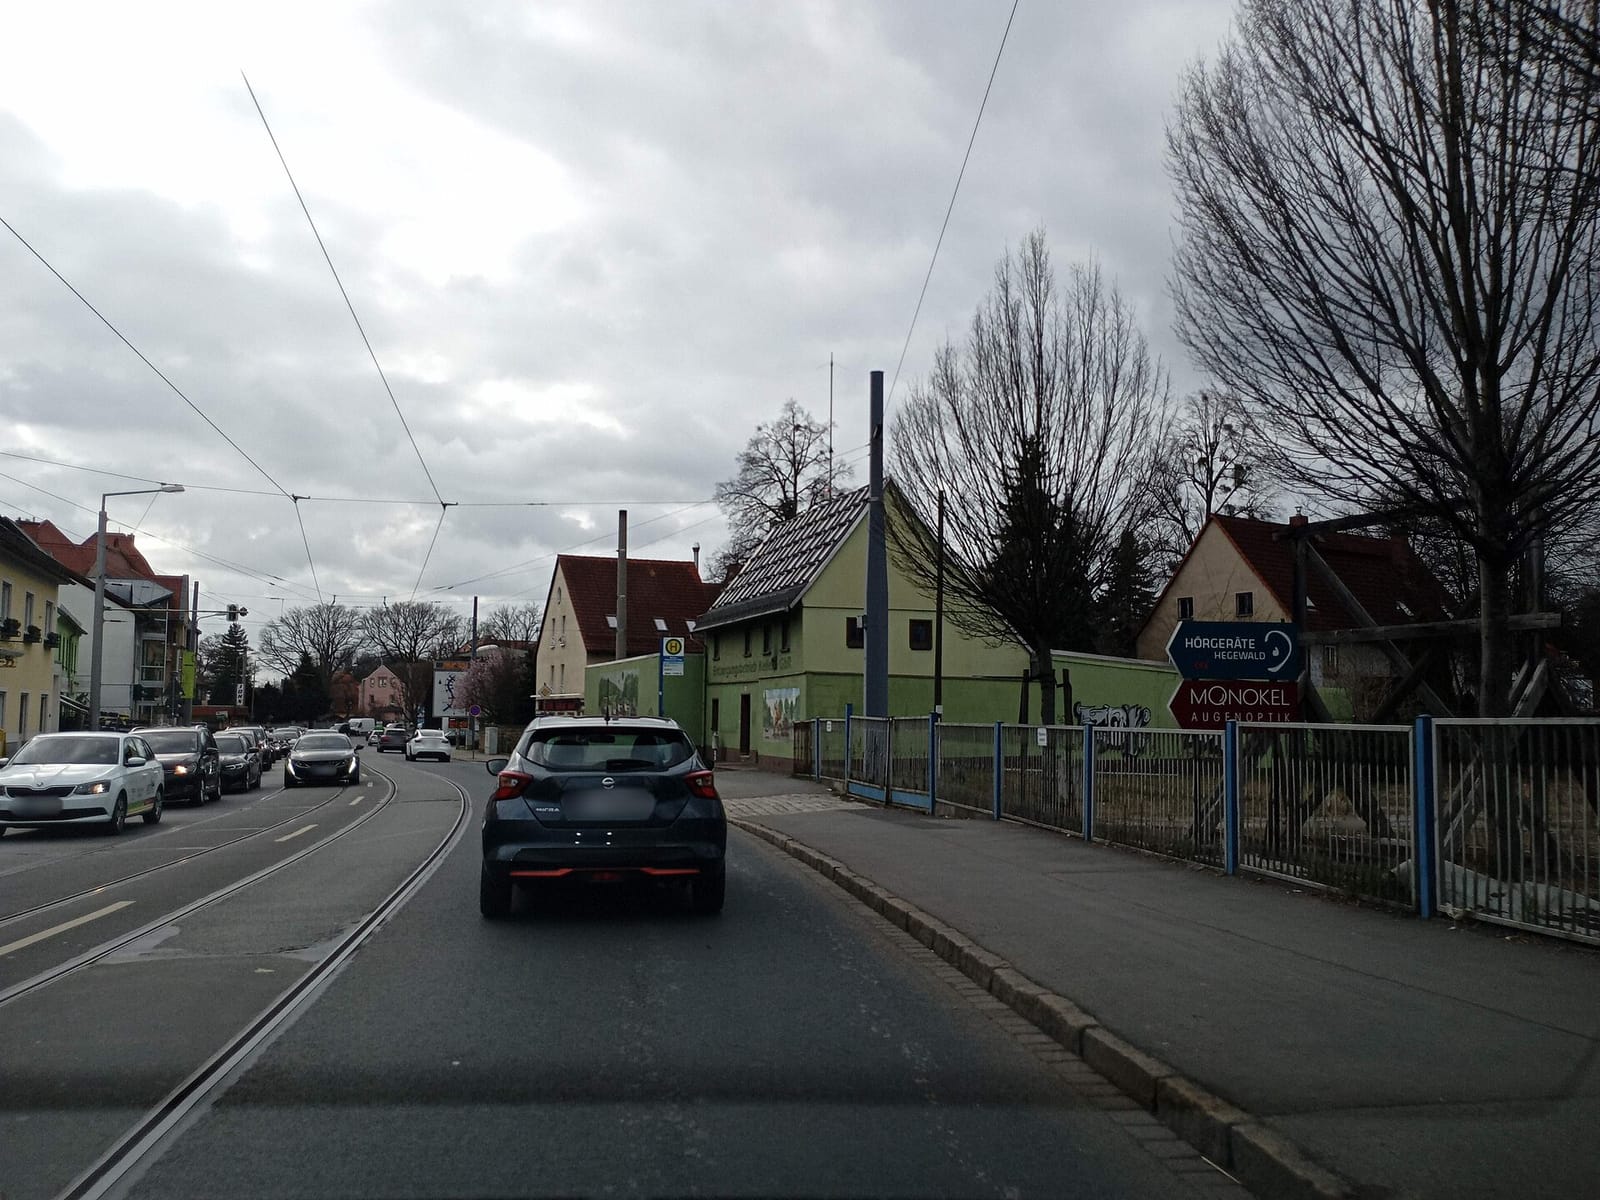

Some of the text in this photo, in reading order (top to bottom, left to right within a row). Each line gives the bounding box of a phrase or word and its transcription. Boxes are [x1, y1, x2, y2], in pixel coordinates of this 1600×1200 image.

[669, 642, 678, 652] H
[1185, 636, 1256, 649] HÖRGERÄTE
[1214, 651, 1266, 660] HEGEWALD
[1190, 685, 1290, 706] MONOKEL
[1191, 711, 1291, 722] AUGENOPTIK
